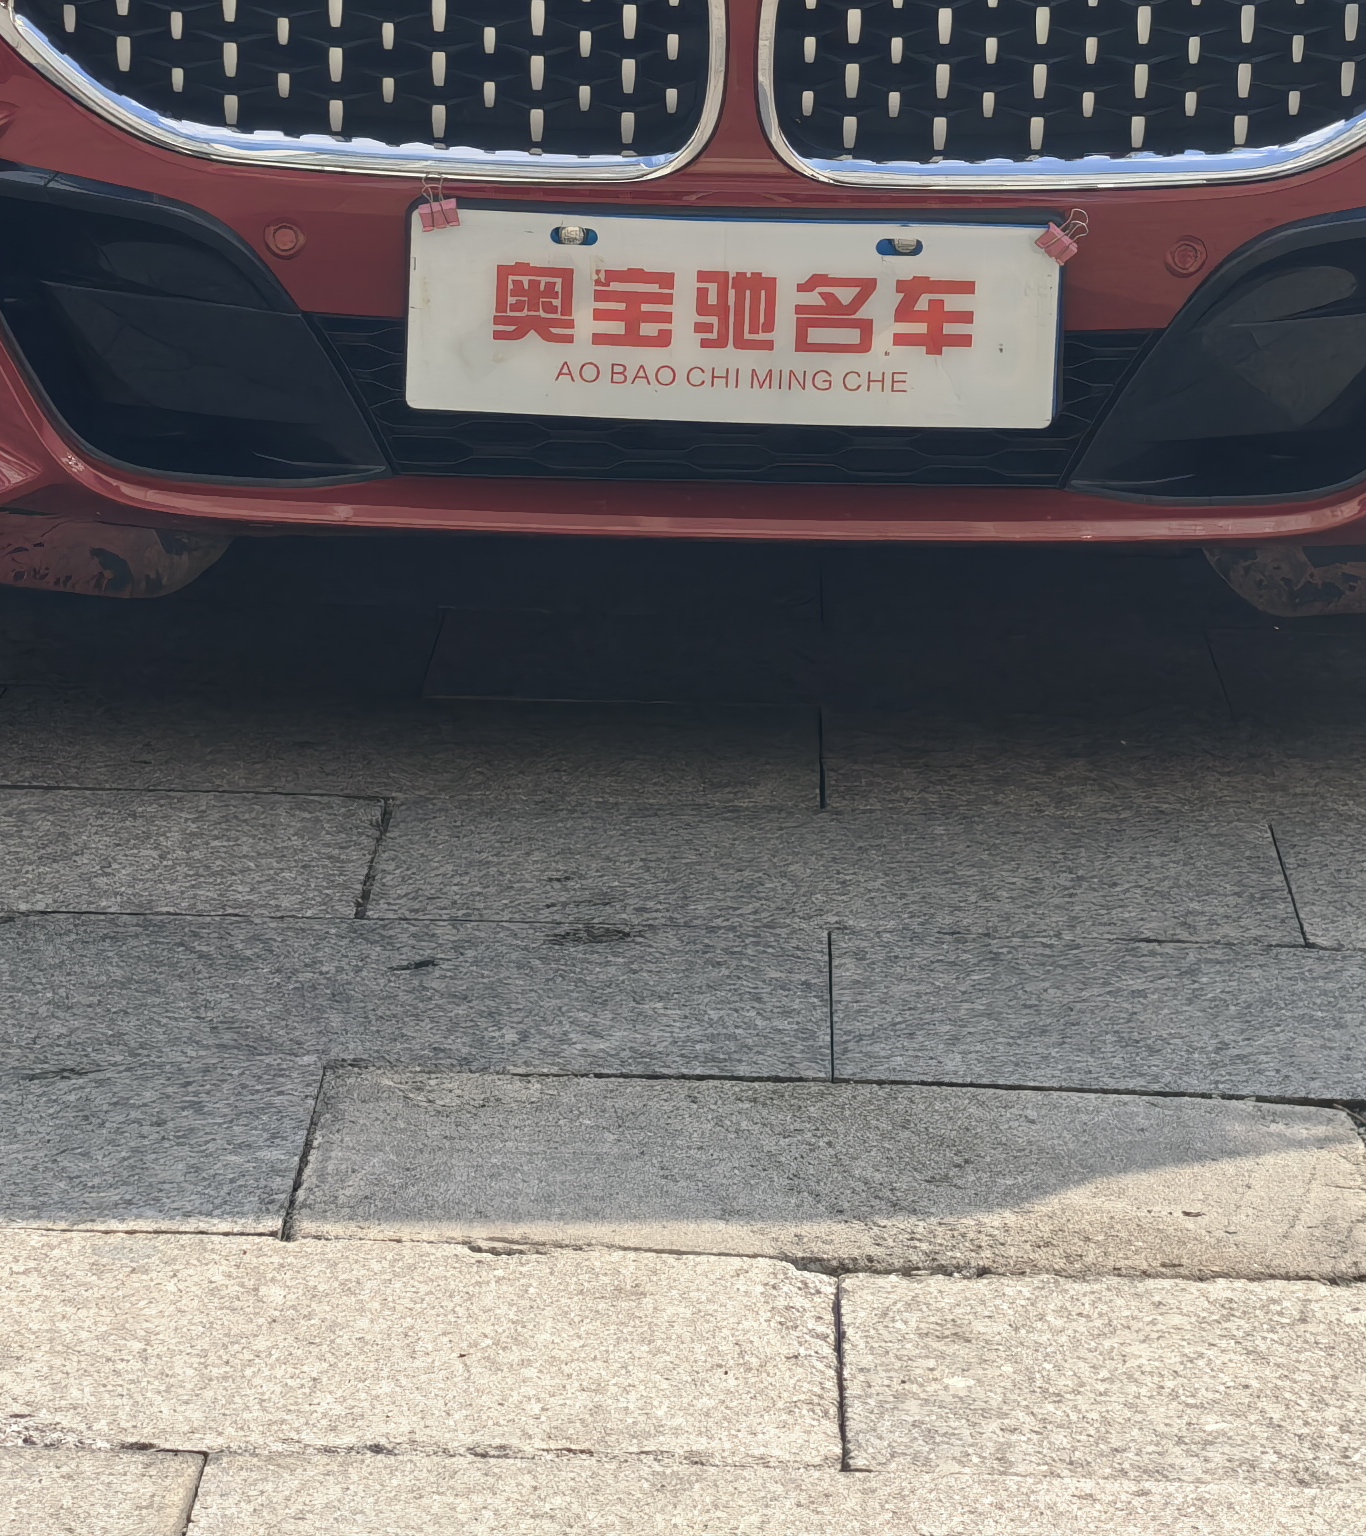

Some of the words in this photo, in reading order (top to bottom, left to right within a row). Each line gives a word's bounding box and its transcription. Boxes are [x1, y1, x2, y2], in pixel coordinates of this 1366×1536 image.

[492, 261, 976, 356] 奥宝驰名车
[554, 360, 601, 384] AO
[610, 363, 677, 387] BAO
[686, 366, 740, 389] CHI
[750, 368, 833, 392] MING
[842, 370, 909, 393] CHE
